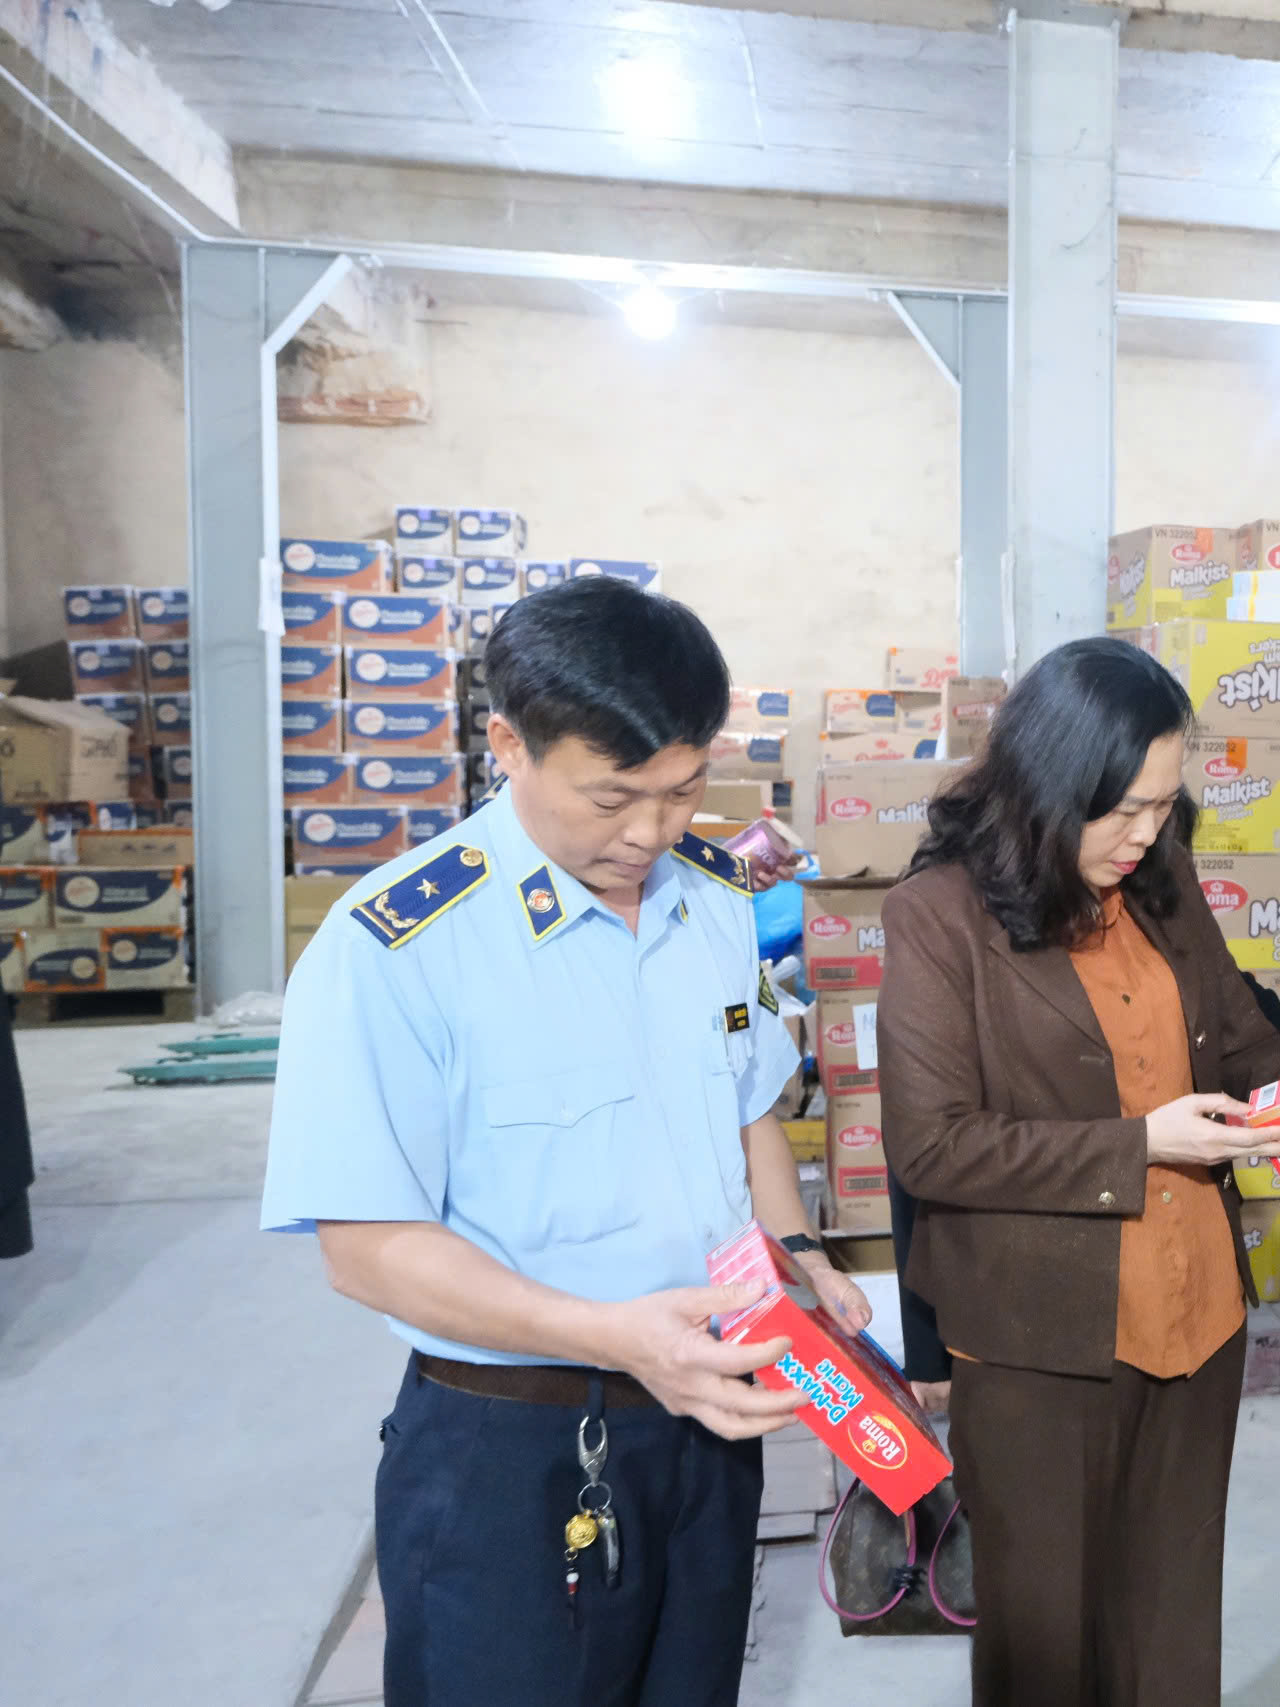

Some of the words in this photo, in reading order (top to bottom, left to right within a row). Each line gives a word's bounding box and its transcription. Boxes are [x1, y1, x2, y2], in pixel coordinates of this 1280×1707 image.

[1169, 560, 1230, 588] Malkist
[1209, 761, 1239, 775] Roma
[1203, 776, 1272, 807] Malkist
[834, 802, 867, 814] Roma
[1200, 859, 1234, 870] 322052
[1206, 893, 1239, 906] oma
[813, 921, 847, 934] Roma
[831, 1029, 857, 1042] Rom
[843, 1131, 881, 1145] Roma
[775, 1352, 849, 1426] D-MAXX
[815, 1358, 864, 1411] Marie
[858, 1415, 901, 1461] Roma
